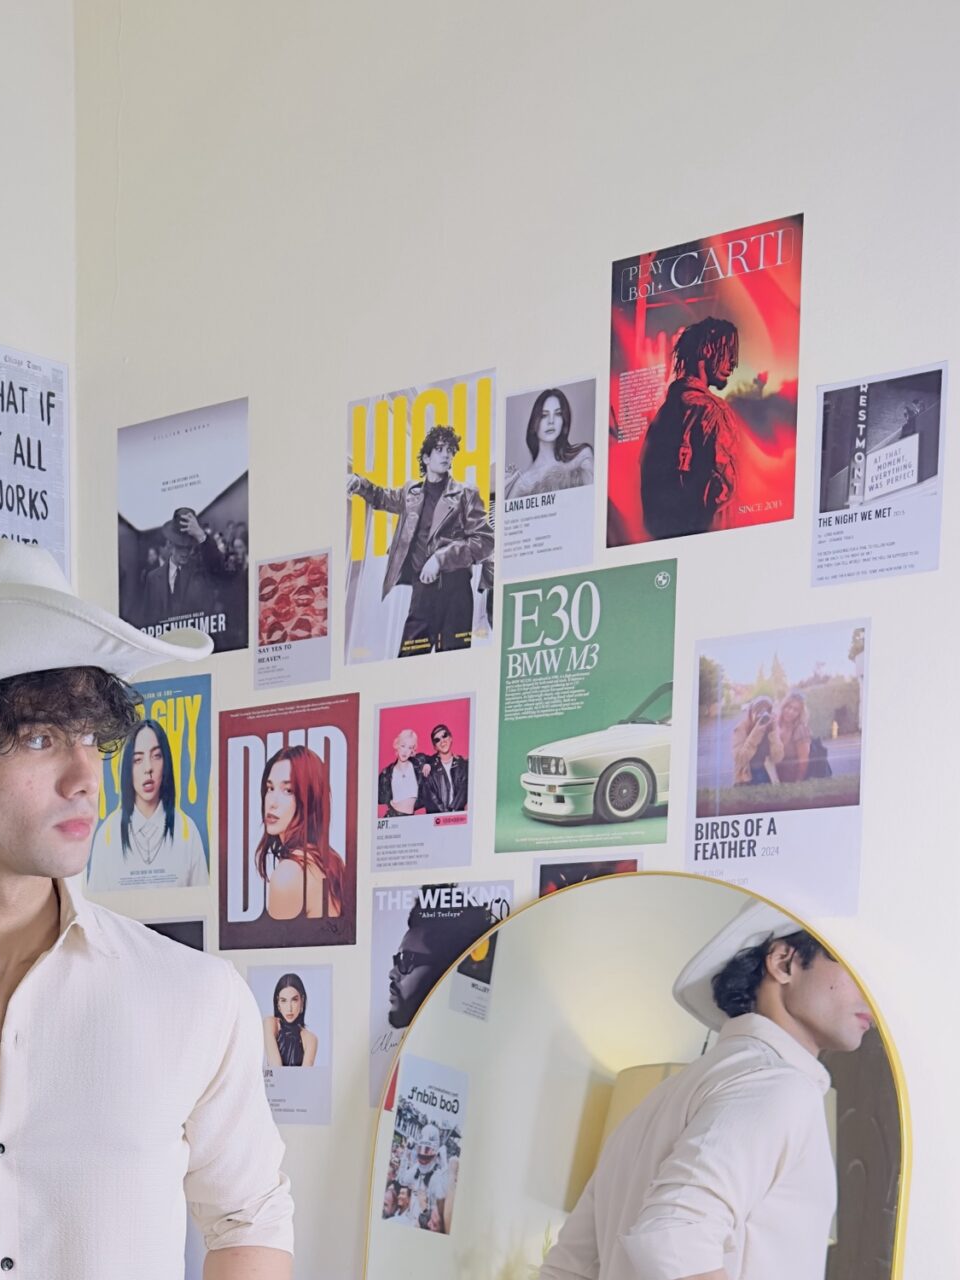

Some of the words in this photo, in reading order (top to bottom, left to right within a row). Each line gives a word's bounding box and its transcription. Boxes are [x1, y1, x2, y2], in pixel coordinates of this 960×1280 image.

[628, 258, 666, 281] PLAY
[670, 230, 784, 289] CARTI
[40, 391, 56, 426] IF
[13, 433, 47, 472] ALL
[874, 454, 881, 464] AT
[885, 448, 902, 459] THAT
[868, 482, 883, 492] WAS
[886, 470, 915, 487] PERFECT
[870, 463, 913, 483] EVERYTHING
[504, 498, 524, 513] LANA
[526, 497, 539, 510] DEL
[541, 494, 556, 506] RAY
[738, 503, 762, 513] SINCE
[818, 516, 833, 528] THE
[834, 512, 858, 526] NIGHT
[860, 510, 873, 521] WE
[874, 507, 892, 519] MET
[507, 580, 601, 650] E30
[257, 647, 270, 655] SAY
[271, 645, 283, 653] YES
[257, 655, 281, 664] HEAVEN
[507, 647, 565, 679] BMW
[566, 643, 600, 672] M3
[694, 819, 741, 841] BIRDS
[744, 817, 763, 837] OF
[767, 817, 777, 836] A
[694, 839, 757, 861] FEATHER
[761, 846, 780, 857] 2024
[375, 889, 414, 911] THE
